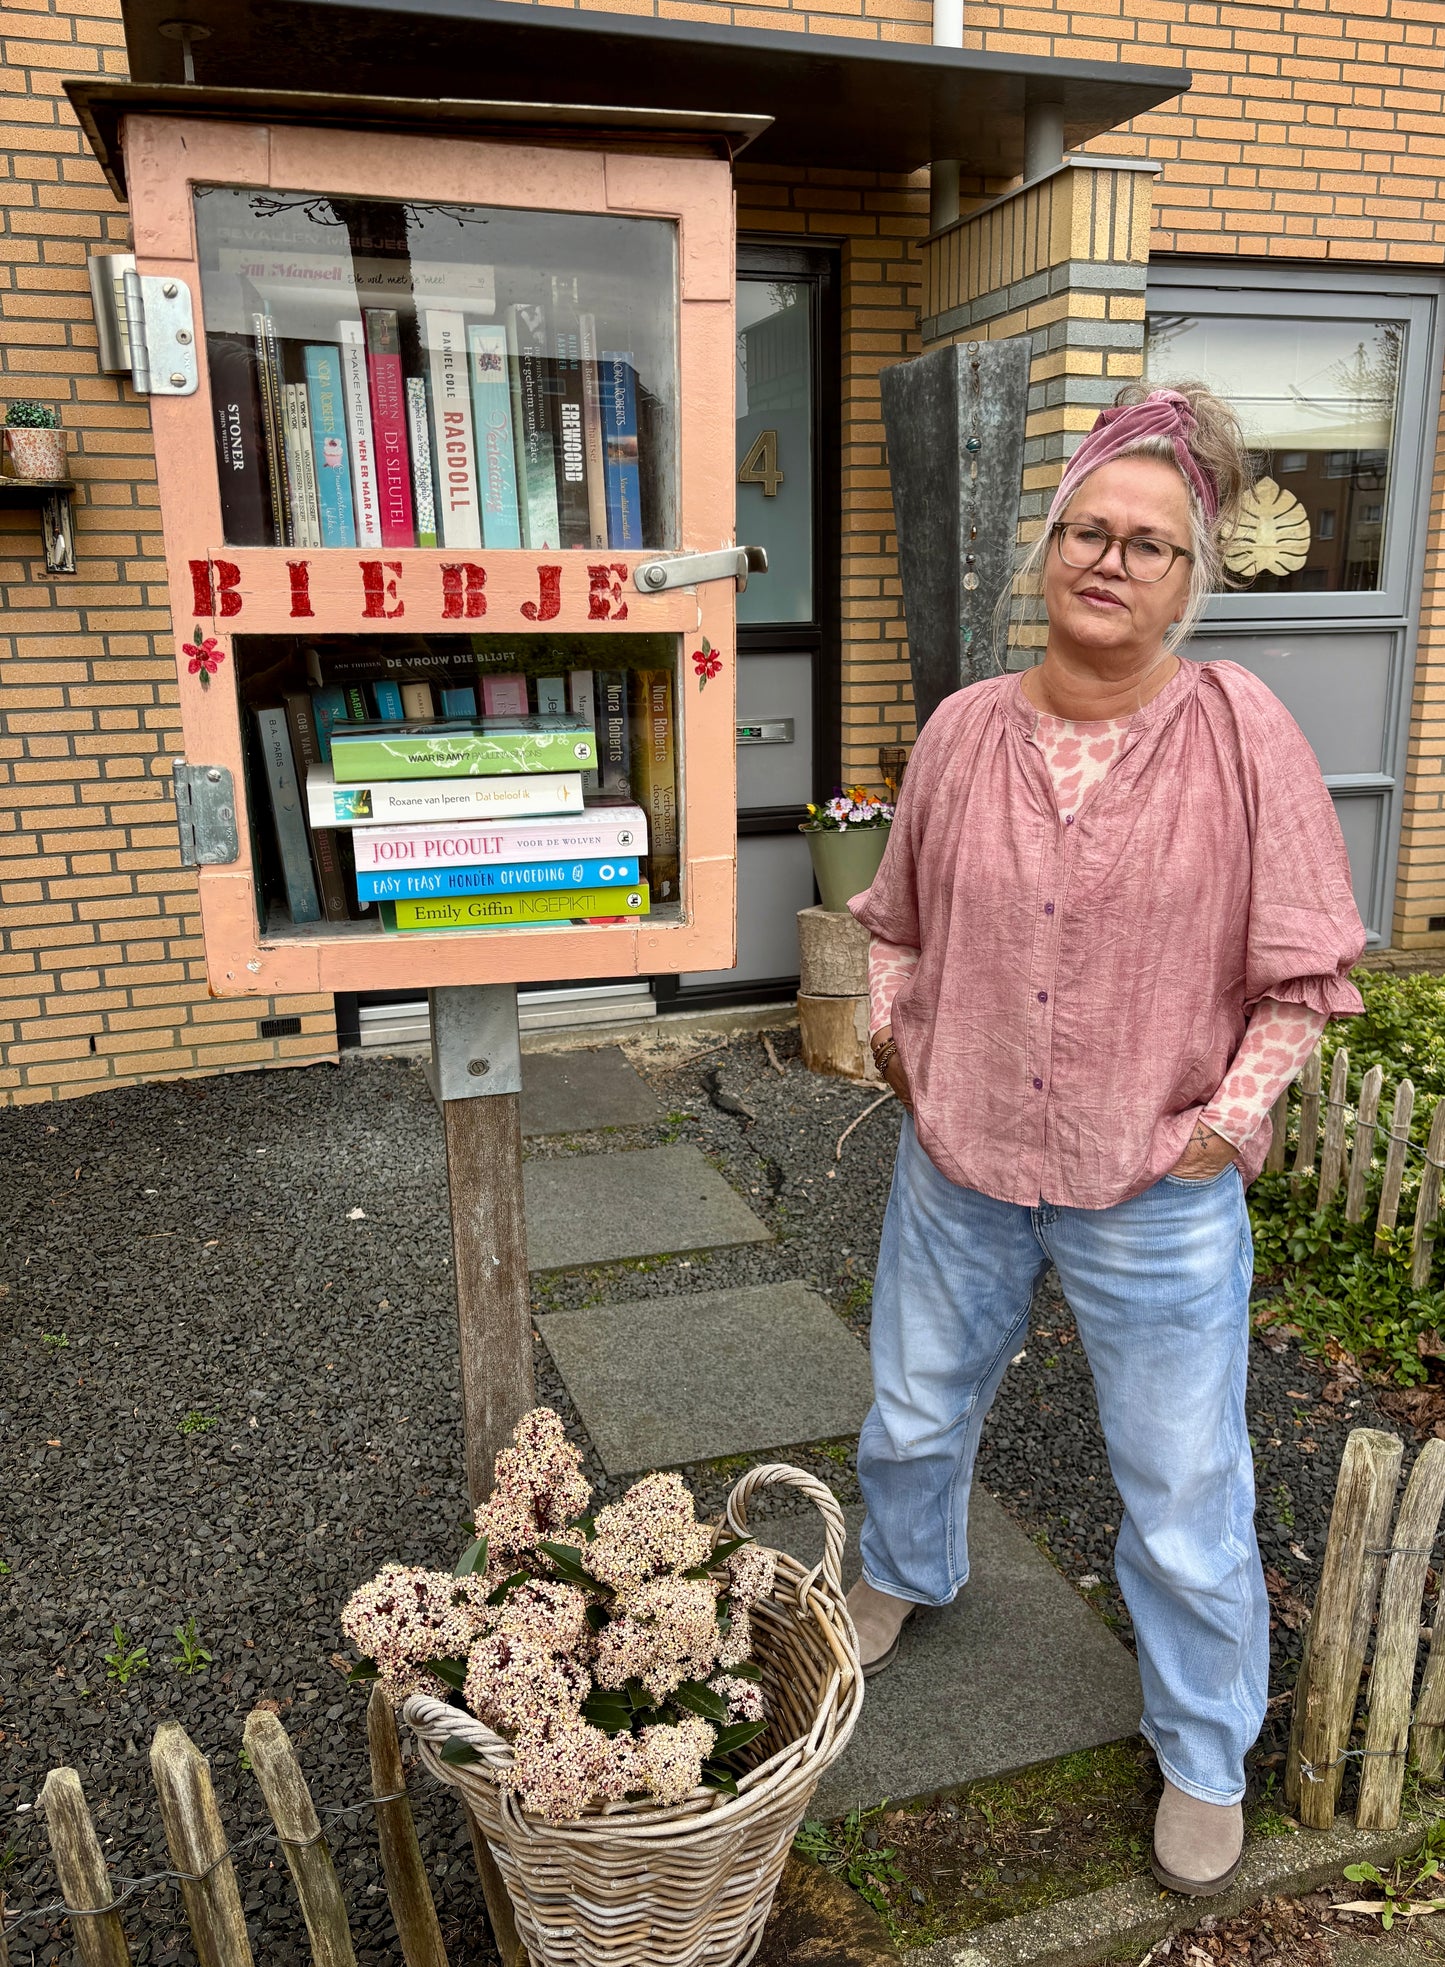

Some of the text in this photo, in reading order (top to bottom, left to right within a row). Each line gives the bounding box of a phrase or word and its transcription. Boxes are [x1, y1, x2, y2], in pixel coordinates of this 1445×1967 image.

[217, 227, 319, 245] GEVALLEN
[268, 263, 343, 281] Mansell
[347, 272, 364, 284] Ik
[368, 273, 384, 284] wil
[387, 274, 408, 285] met
[523, 346, 533, 366] Het
[557, 333, 578, 370] WILLIAM LASHNER
[583, 333, 593, 366] Nando
[317, 359, 335, 433] NORA ROBERTS
[375, 363, 399, 419] KATHRYN HUGHES
[523, 368, 537, 409] geheim
[585, 367, 593, 394] Boers
[612, 357, 626, 426] NORA ROBERTS
[289, 401, 298, 429] YOK-YOK
[299, 401, 307, 429] YOK-YOK
[442, 331, 470, 512] DANIEL COLE RAGDOLL
[218, 410, 230, 464] JOHN WILLIAMS
[227, 403, 245, 471] STONER
[350, 349, 374, 534] MAIKE MEIJER WEN ER MAAR AAN
[561, 403, 584, 482] EREWOORD
[384, 432, 405, 528] DE SLEUTEL
[484, 409, 509, 513] Verleiding
[737, 430, 784, 497] 4
[188, 559, 630, 622] BIEBJE
[334, 662, 349, 670] ANN
[386, 658, 402, 668] DE
[404, 654, 450, 668] VROUW
[453, 654, 474, 665] DIE
[477, 651, 516, 663] BLIJFT
[607, 684, 623, 712] Nora
[296, 712, 308, 734] COBI
[608, 717, 624, 762] Roberts
[652, 684, 668, 762] Nora Roberts
[268, 719, 284, 768] B.A. PARIS
[301, 737, 313, 755] VAN
[408, 754, 435, 763] WAAR
[436, 753, 445, 762] IS
[446, 752, 470, 761] AMY?
[388, 788, 530, 807] Roxane van Iperen Dat beloof ik
[653, 784, 664, 849] door het lot
[663, 785, 674, 845] Verbonden
[372, 841, 416, 864] JODI
[423, 836, 504, 858] PICOULT
[516, 840, 543, 848] VOOR
[562, 836, 601, 845] WOLVEN
[373, 876, 401, 895] EASY
[407, 873, 442, 892] PEASY
[448, 871, 495, 888] HONDEN
[500, 867, 565, 885] OPVOEDING
[414, 895, 597, 922] Emily Giffin INGEPIKT!
